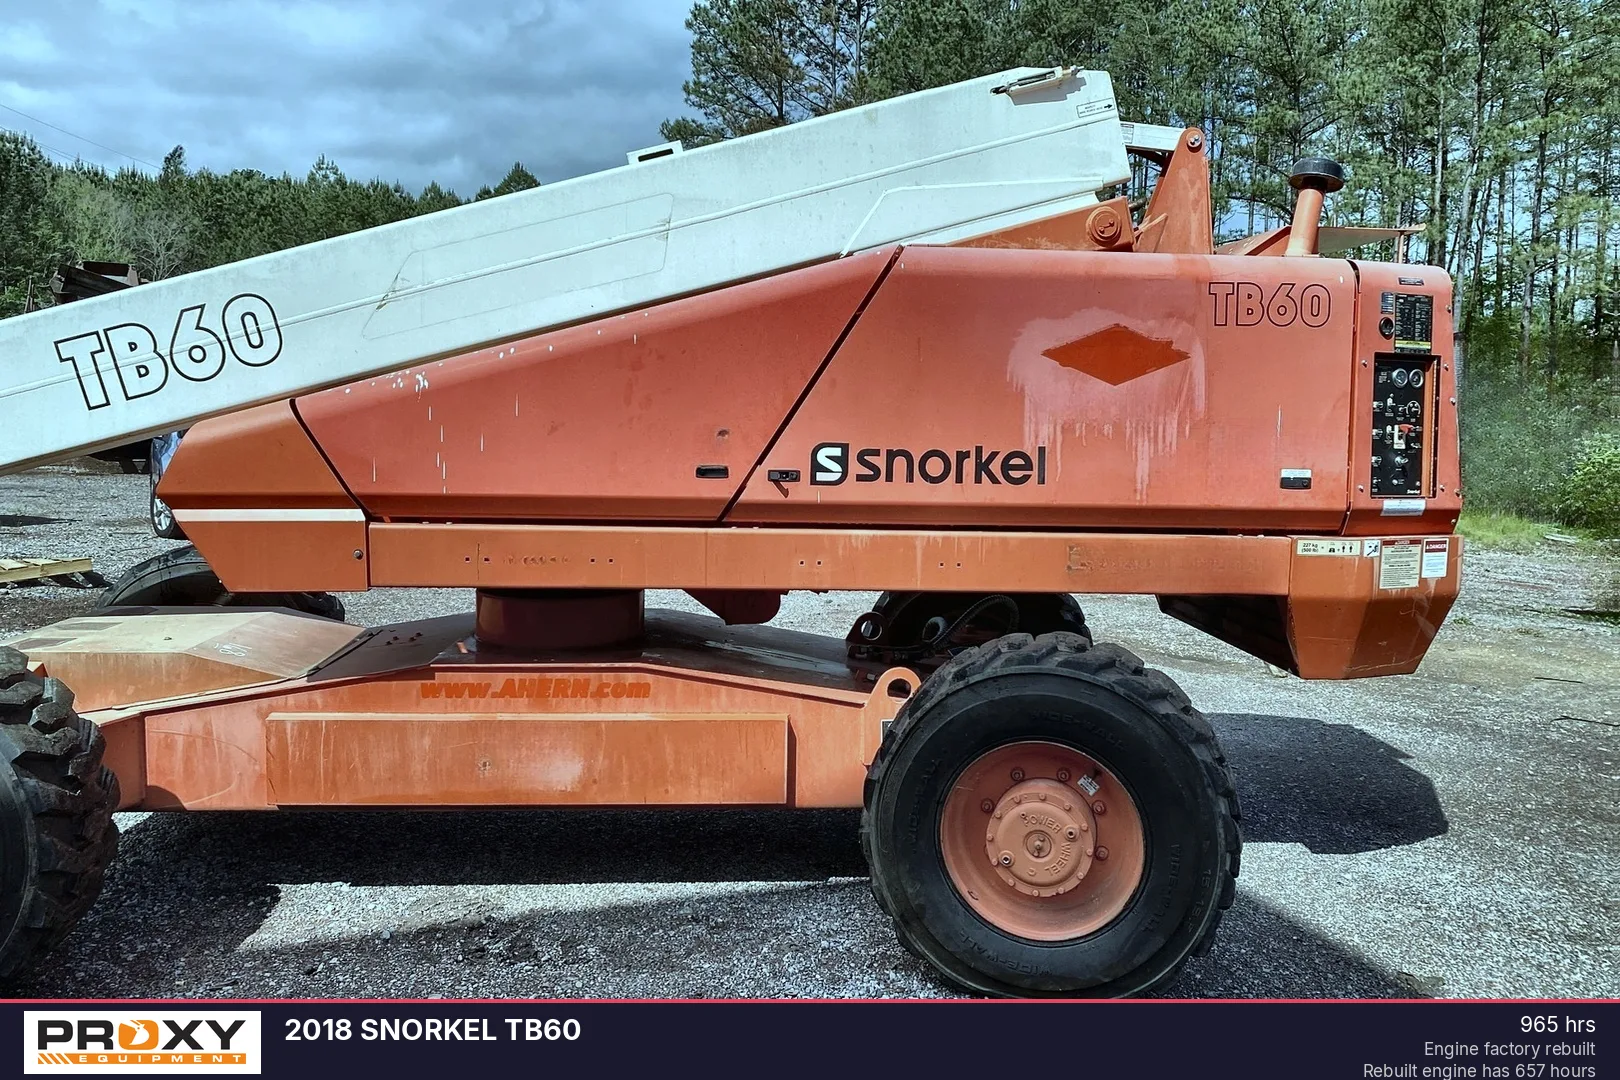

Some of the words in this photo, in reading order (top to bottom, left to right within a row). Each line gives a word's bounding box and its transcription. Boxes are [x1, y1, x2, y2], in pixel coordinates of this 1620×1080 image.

[1208, 281, 1332, 328] TB60
[53, 292, 284, 411] TB60
[855, 445, 1046, 486] snorkel
[420, 678, 650, 699] www.AHERN.com
[1044, 842, 1072, 876] WHEEL
